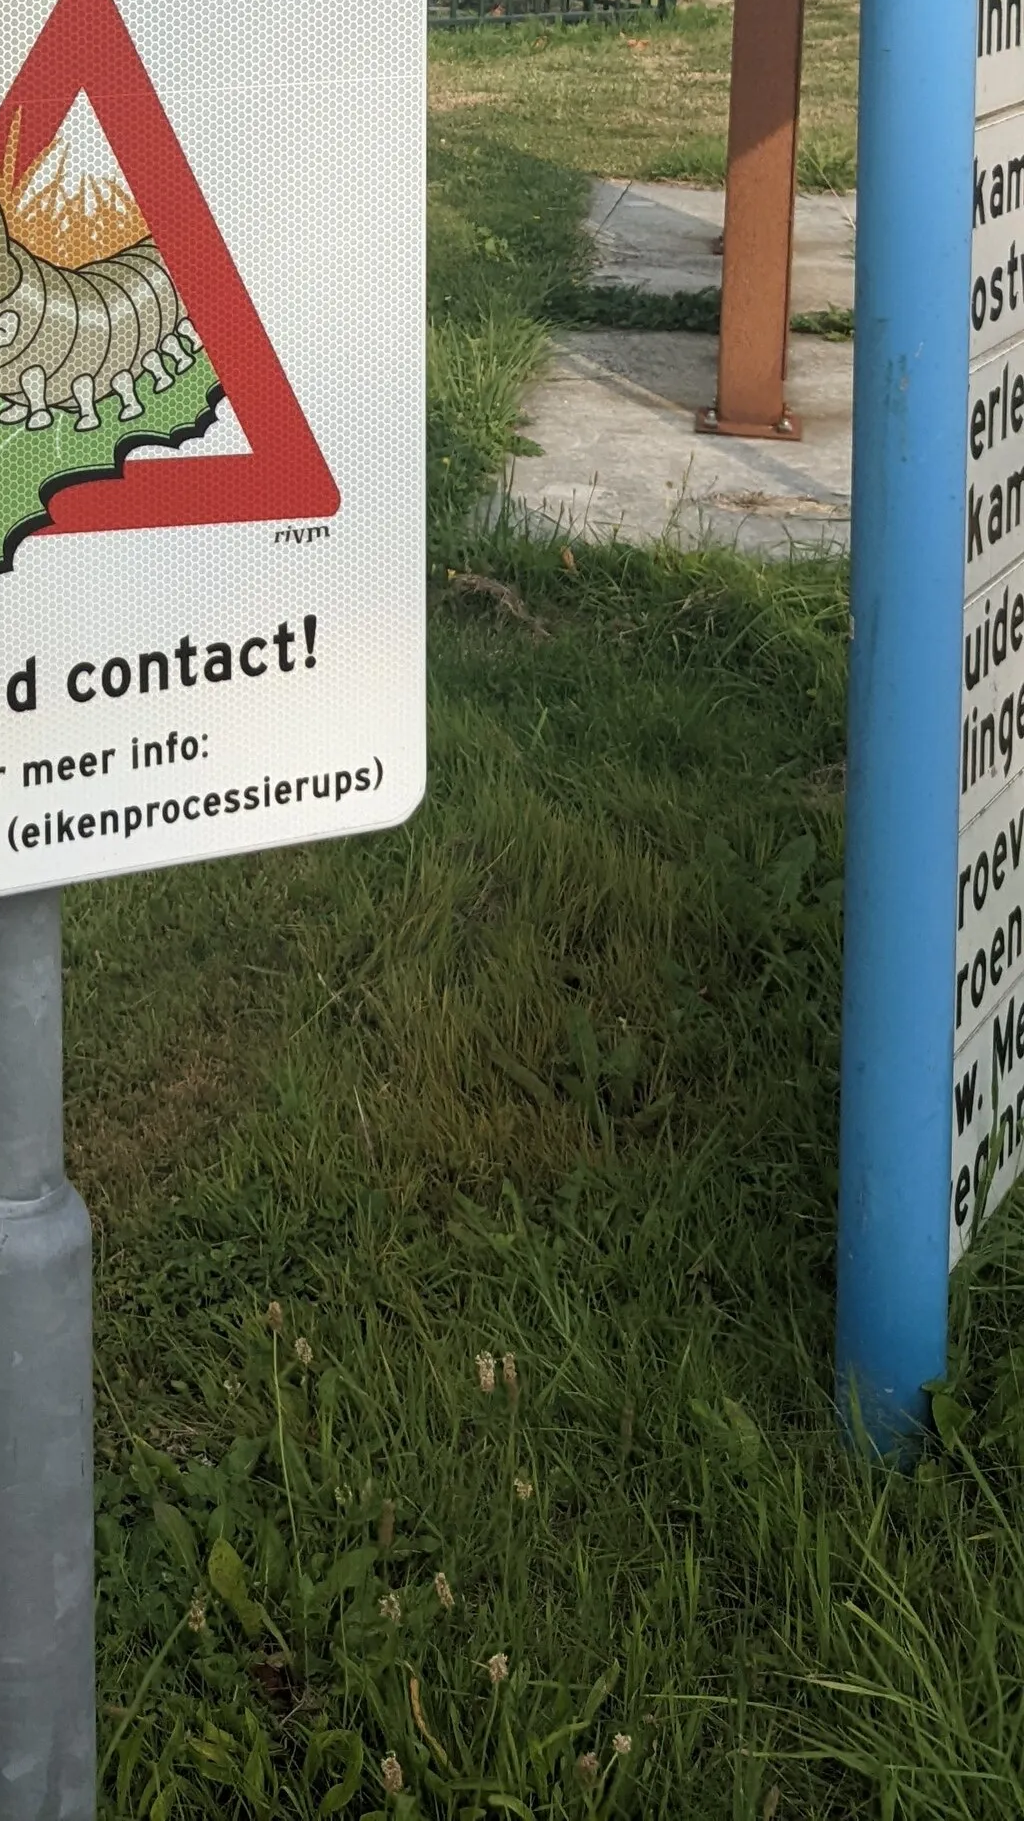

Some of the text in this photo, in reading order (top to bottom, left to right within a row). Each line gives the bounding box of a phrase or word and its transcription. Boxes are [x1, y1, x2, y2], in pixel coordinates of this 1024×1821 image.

[274, 525, 331, 544] rivm
[66, 614, 318, 703] contact!
[22, 747, 117, 788] meer
[130, 730, 209, 770] info:
[6, 755, 384, 853] (eikenprocessierups)
